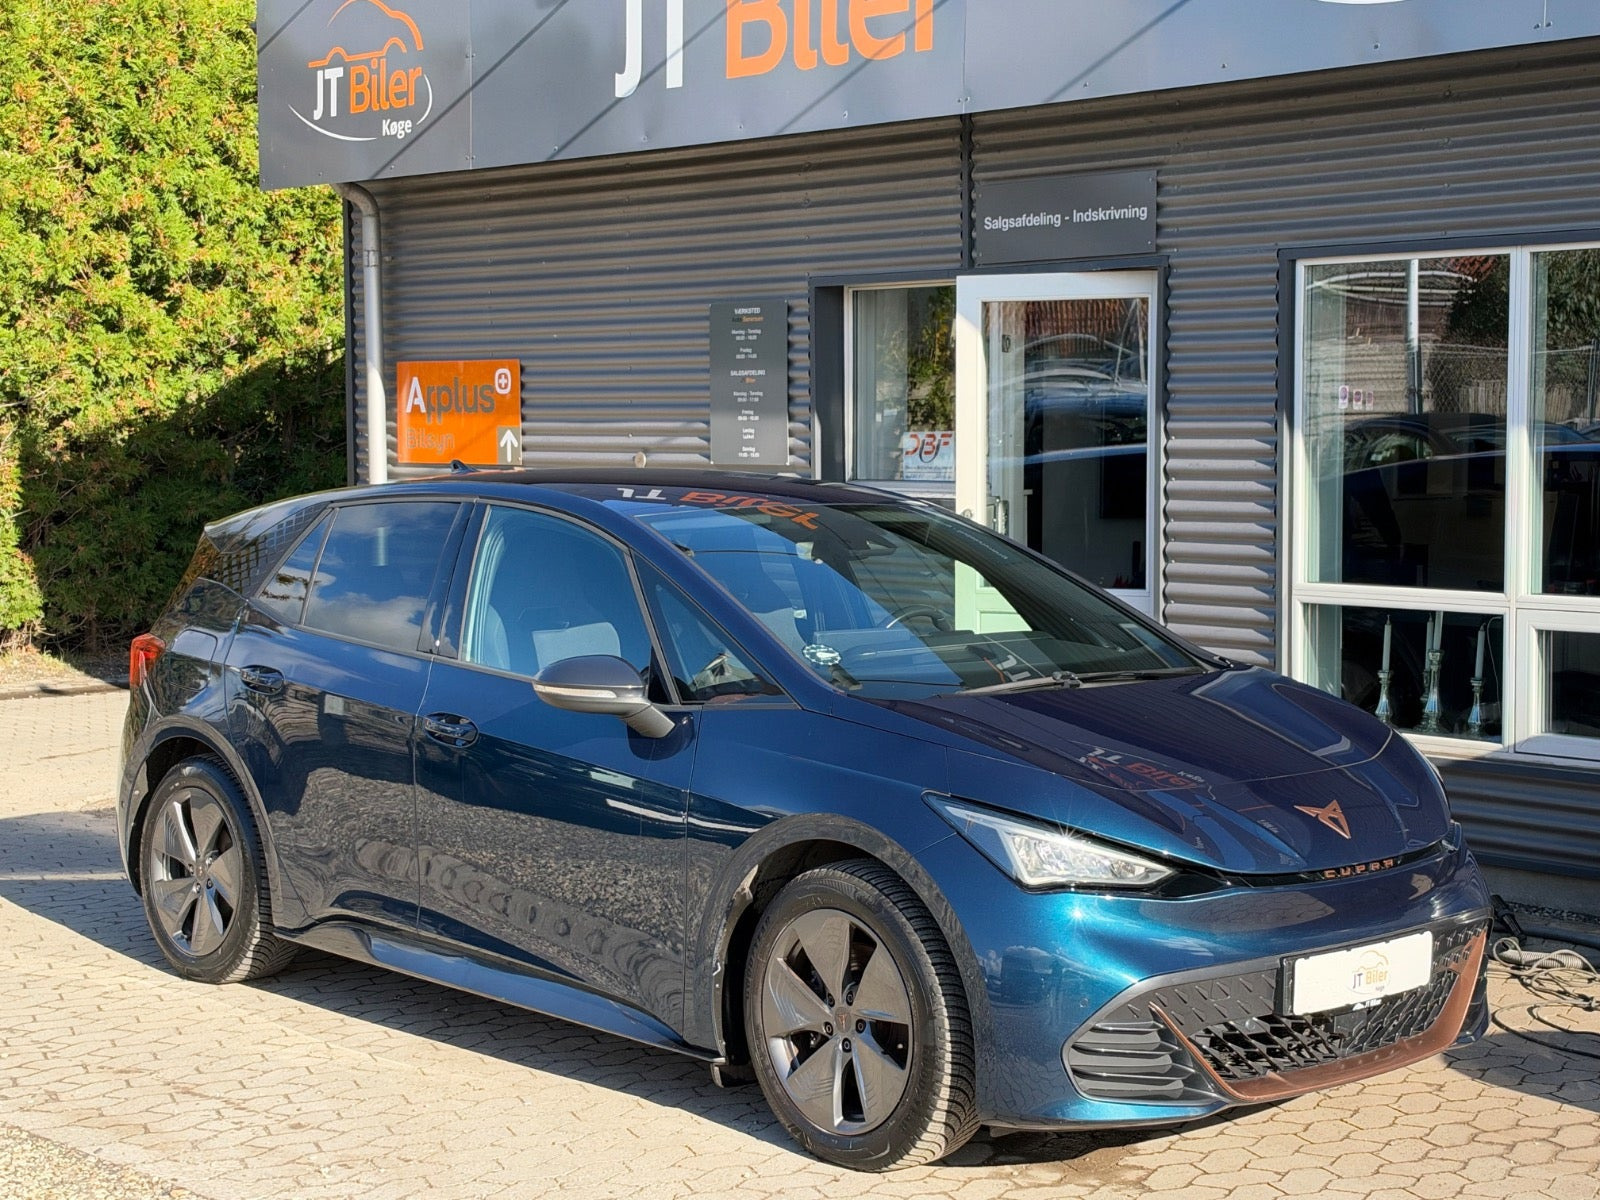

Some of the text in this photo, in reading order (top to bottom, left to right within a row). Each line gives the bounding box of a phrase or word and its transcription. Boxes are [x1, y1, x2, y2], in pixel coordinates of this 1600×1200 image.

[313, 58, 422, 121] JT Biler
[382, 118, 413, 139] Køge
[984, 212, 1061, 231] Salgsafdeling
[1073, 205, 1148, 223] Indskrivning
[406, 428, 454, 455] Bilsyn
[1324, 859, 1394, 879] CUPRA
[1353, 970, 1388, 989] JT Biler
